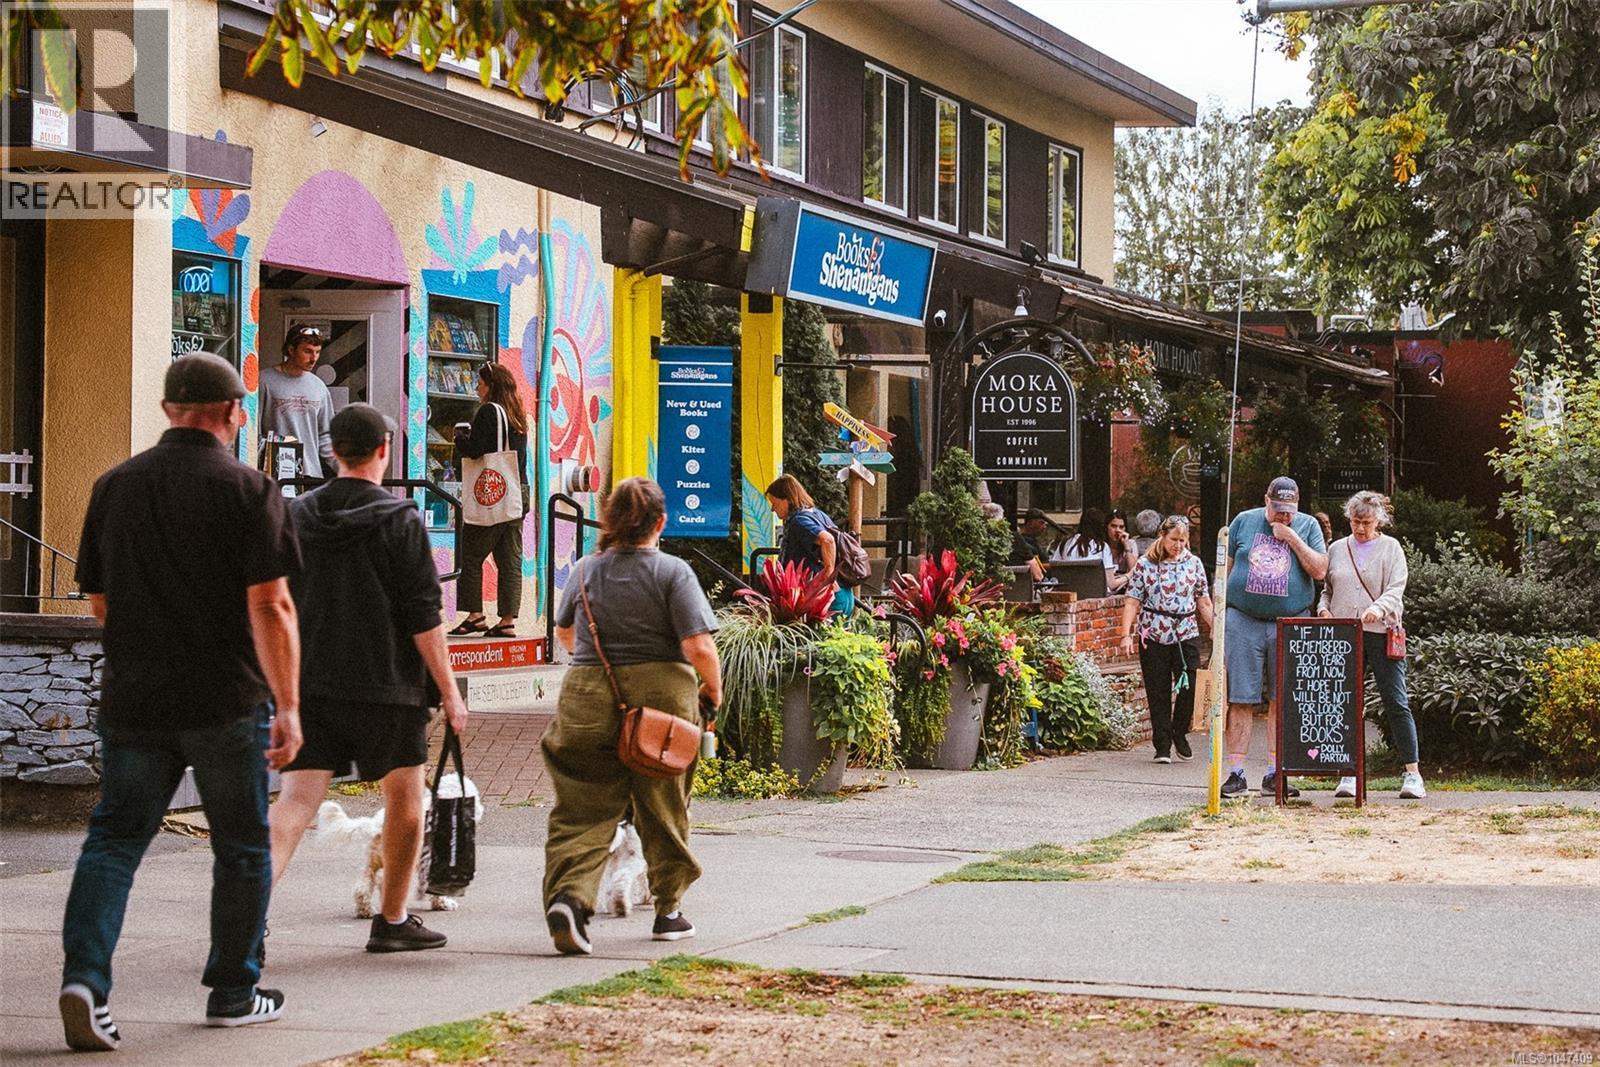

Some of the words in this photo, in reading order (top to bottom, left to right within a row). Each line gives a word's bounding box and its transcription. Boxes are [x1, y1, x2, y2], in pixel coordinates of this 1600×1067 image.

[836, 232, 871, 268] Books
[819, 251, 900, 306] Shenanigans
[670, 371, 719, 381] Shenanigans
[988, 374, 1058, 392] MOKA
[666, 400, 688, 408] New
[689, 400, 698, 408] &
[700, 400, 722, 409] Used
[981, 396, 1063, 414] HOUSE
[679, 408, 708, 417] Books
[835, 411, 870, 439] HAPPINESS
[1006, 437, 1039, 446] COFFEE
[681, 445, 706, 454] Kites
[996, 457, 1049, 466] COMMUNITY
[676, 480, 711, 489] Puzzles
[679, 515, 706, 524] Cards
[1319, 626, 1334, 639] I'M
[1289, 640, 1352, 654] REMEMBERED
[448, 645, 504, 668] orrespondent
[1295, 654, 1318, 666] 100
[1321, 653, 1346, 666] YEARS
[1296, 666, 1320, 678] FROM
[1323, 666, 1346, 680] NOW,
[1296, 679, 1304, 690] I
[1307, 680, 1331, 692] HOPE
[1334, 679, 1345, 692] IT
[1292, 691, 1317, 702] WILL
[1319, 691, 1331, 704] BE
[1333, 691, 1352, 705] NOT
[1298, 703, 1316, 714] FOR
[1318, 703, 1345, 715] LOOKS
[1302, 713, 1322, 726] BUT
[1325, 714, 1344, 727] FOR
[1320, 753, 1350, 763] PARTON
